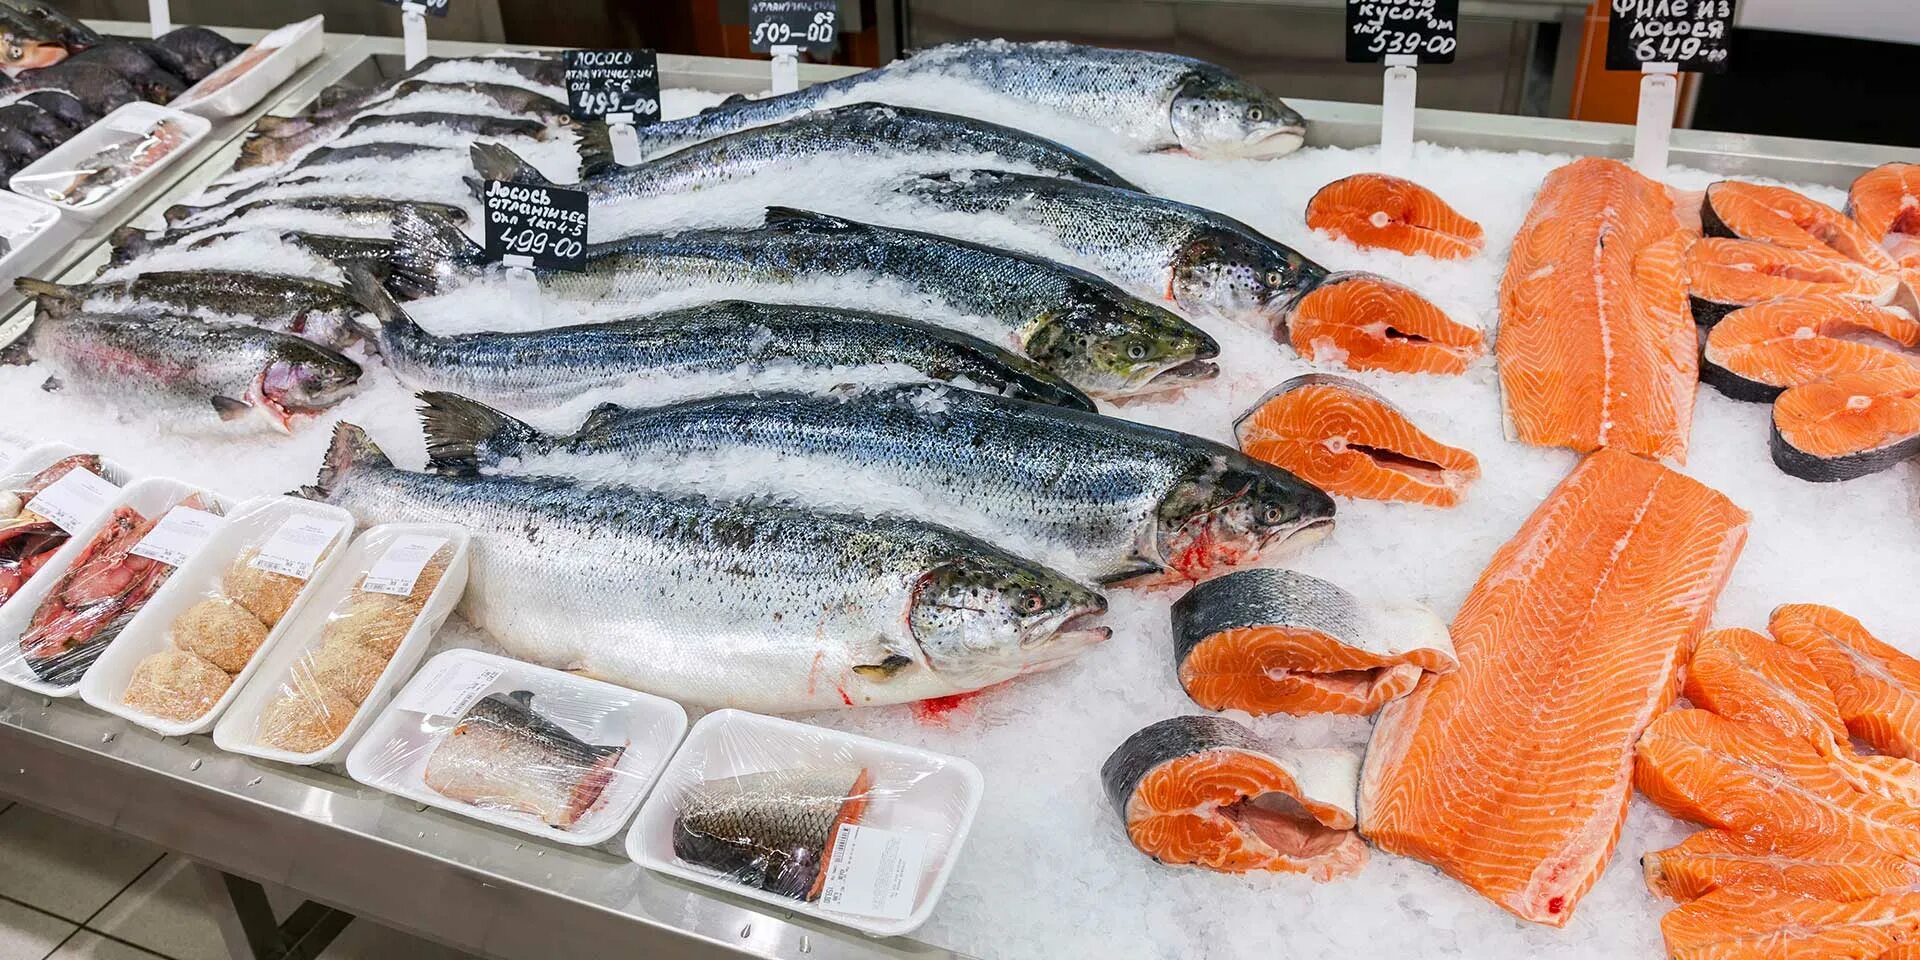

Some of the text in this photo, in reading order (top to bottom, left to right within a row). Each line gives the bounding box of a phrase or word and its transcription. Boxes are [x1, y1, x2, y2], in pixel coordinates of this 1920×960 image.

[752, 22, 833, 44] 509-00
[1368, 30, 1456, 54] 539-00
[579, 90, 658, 115] 499-00
[500, 226, 582, 258] 499-00
